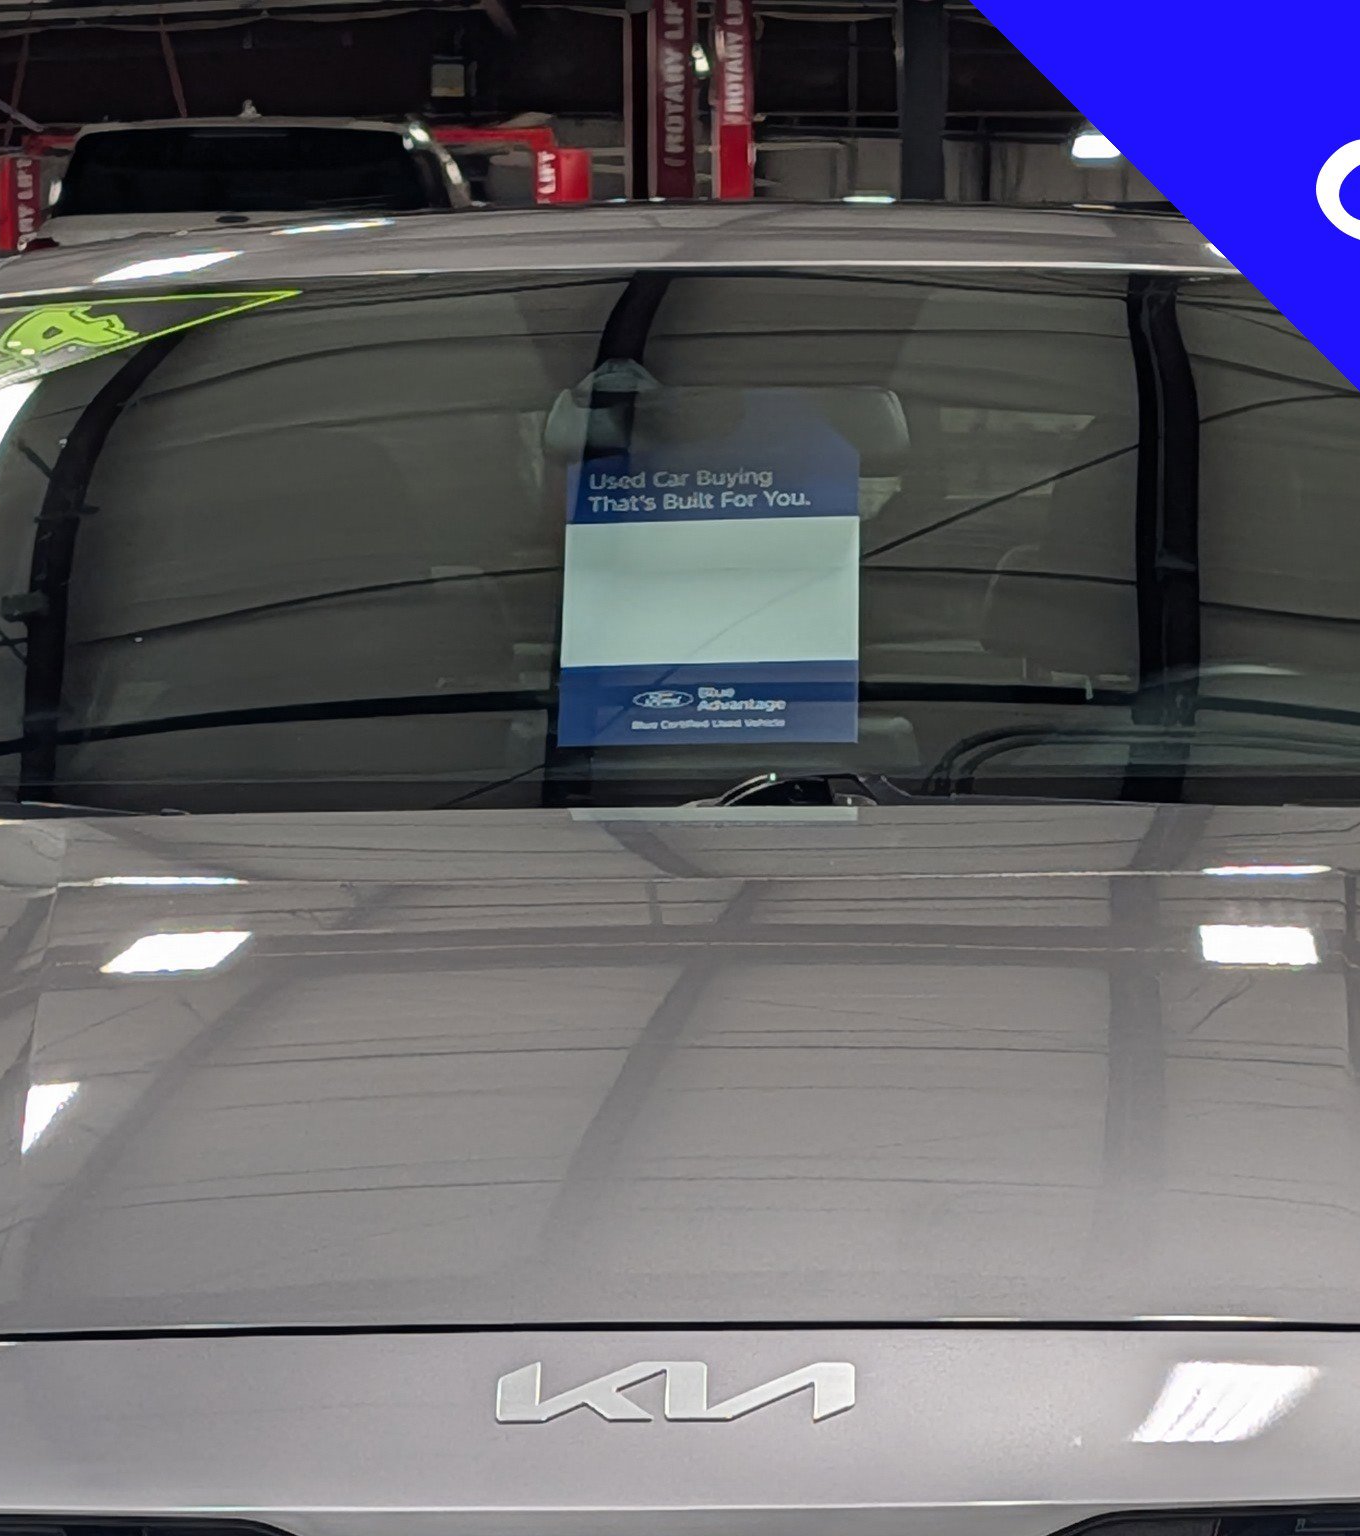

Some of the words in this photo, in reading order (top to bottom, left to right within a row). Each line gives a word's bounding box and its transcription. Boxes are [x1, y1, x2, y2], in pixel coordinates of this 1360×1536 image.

[724, 31, 745, 113] ROTARY
[663, 47, 685, 153] ROTARY
[537, 151, 556, 194] LIFT
[590, 471, 646, 490] Used
[652, 471, 690, 488] Car
[696, 467, 773, 488] Buying
[589, 494, 657, 513] That's
[663, 491, 714, 510] Built
[721, 490, 757, 508] For
[762, 489, 811, 507] You.
[696, 699, 787, 712] Advantage
[496, 1361, 855, 1423] KIA
